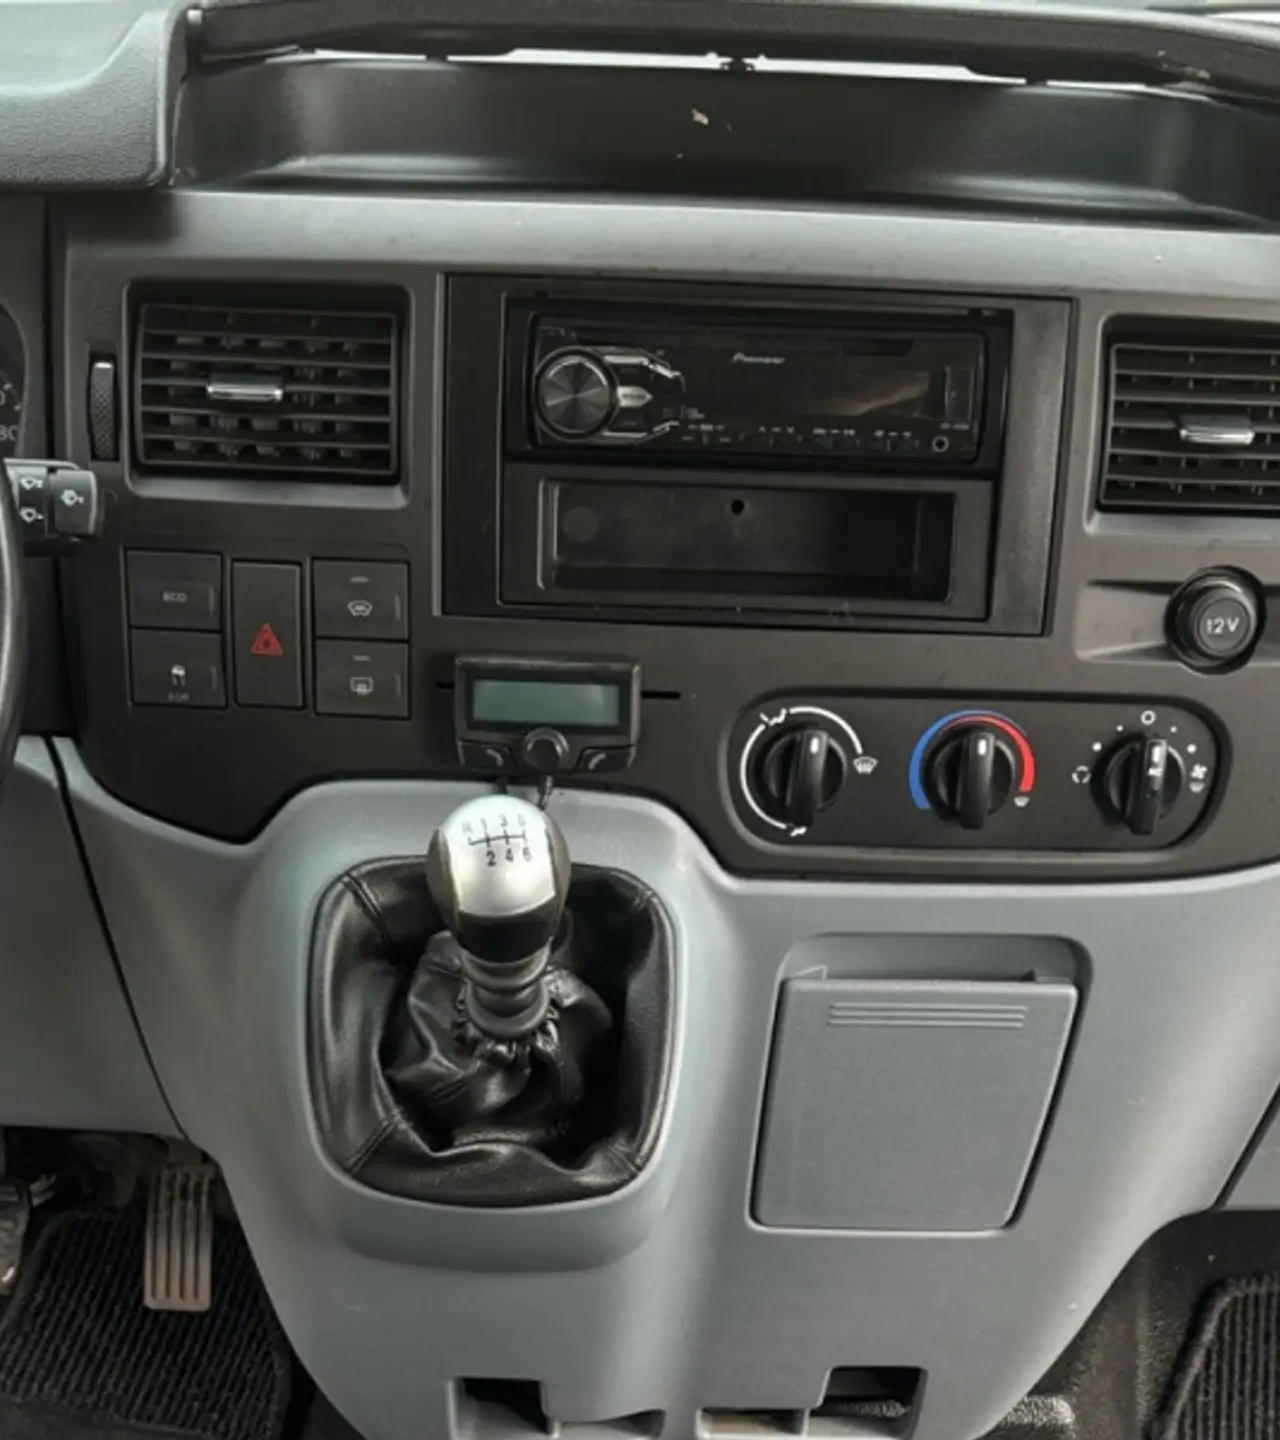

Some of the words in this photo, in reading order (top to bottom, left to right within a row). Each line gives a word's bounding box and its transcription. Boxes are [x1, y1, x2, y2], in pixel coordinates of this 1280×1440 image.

[486, 850, 497, 868] 2
[505, 848, 514, 863] 4
[522, 846, 533, 863] 6
